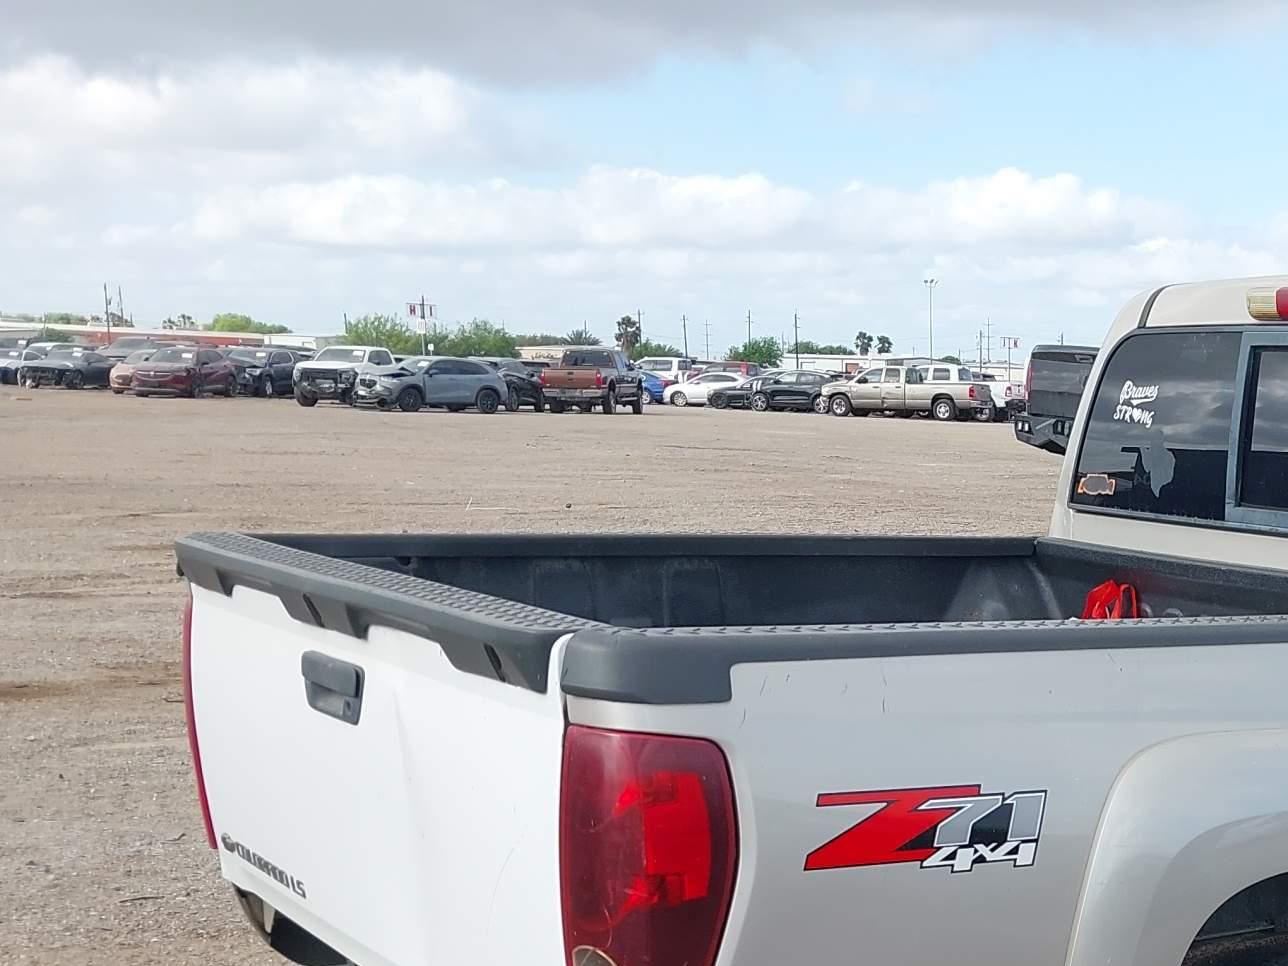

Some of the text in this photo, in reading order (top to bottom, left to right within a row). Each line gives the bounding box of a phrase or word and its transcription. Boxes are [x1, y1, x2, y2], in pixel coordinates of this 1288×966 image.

[1120, 380, 1159, 405] Braves
[804, 784, 1047, 871] Z71
[290, 875, 306, 899] LS
